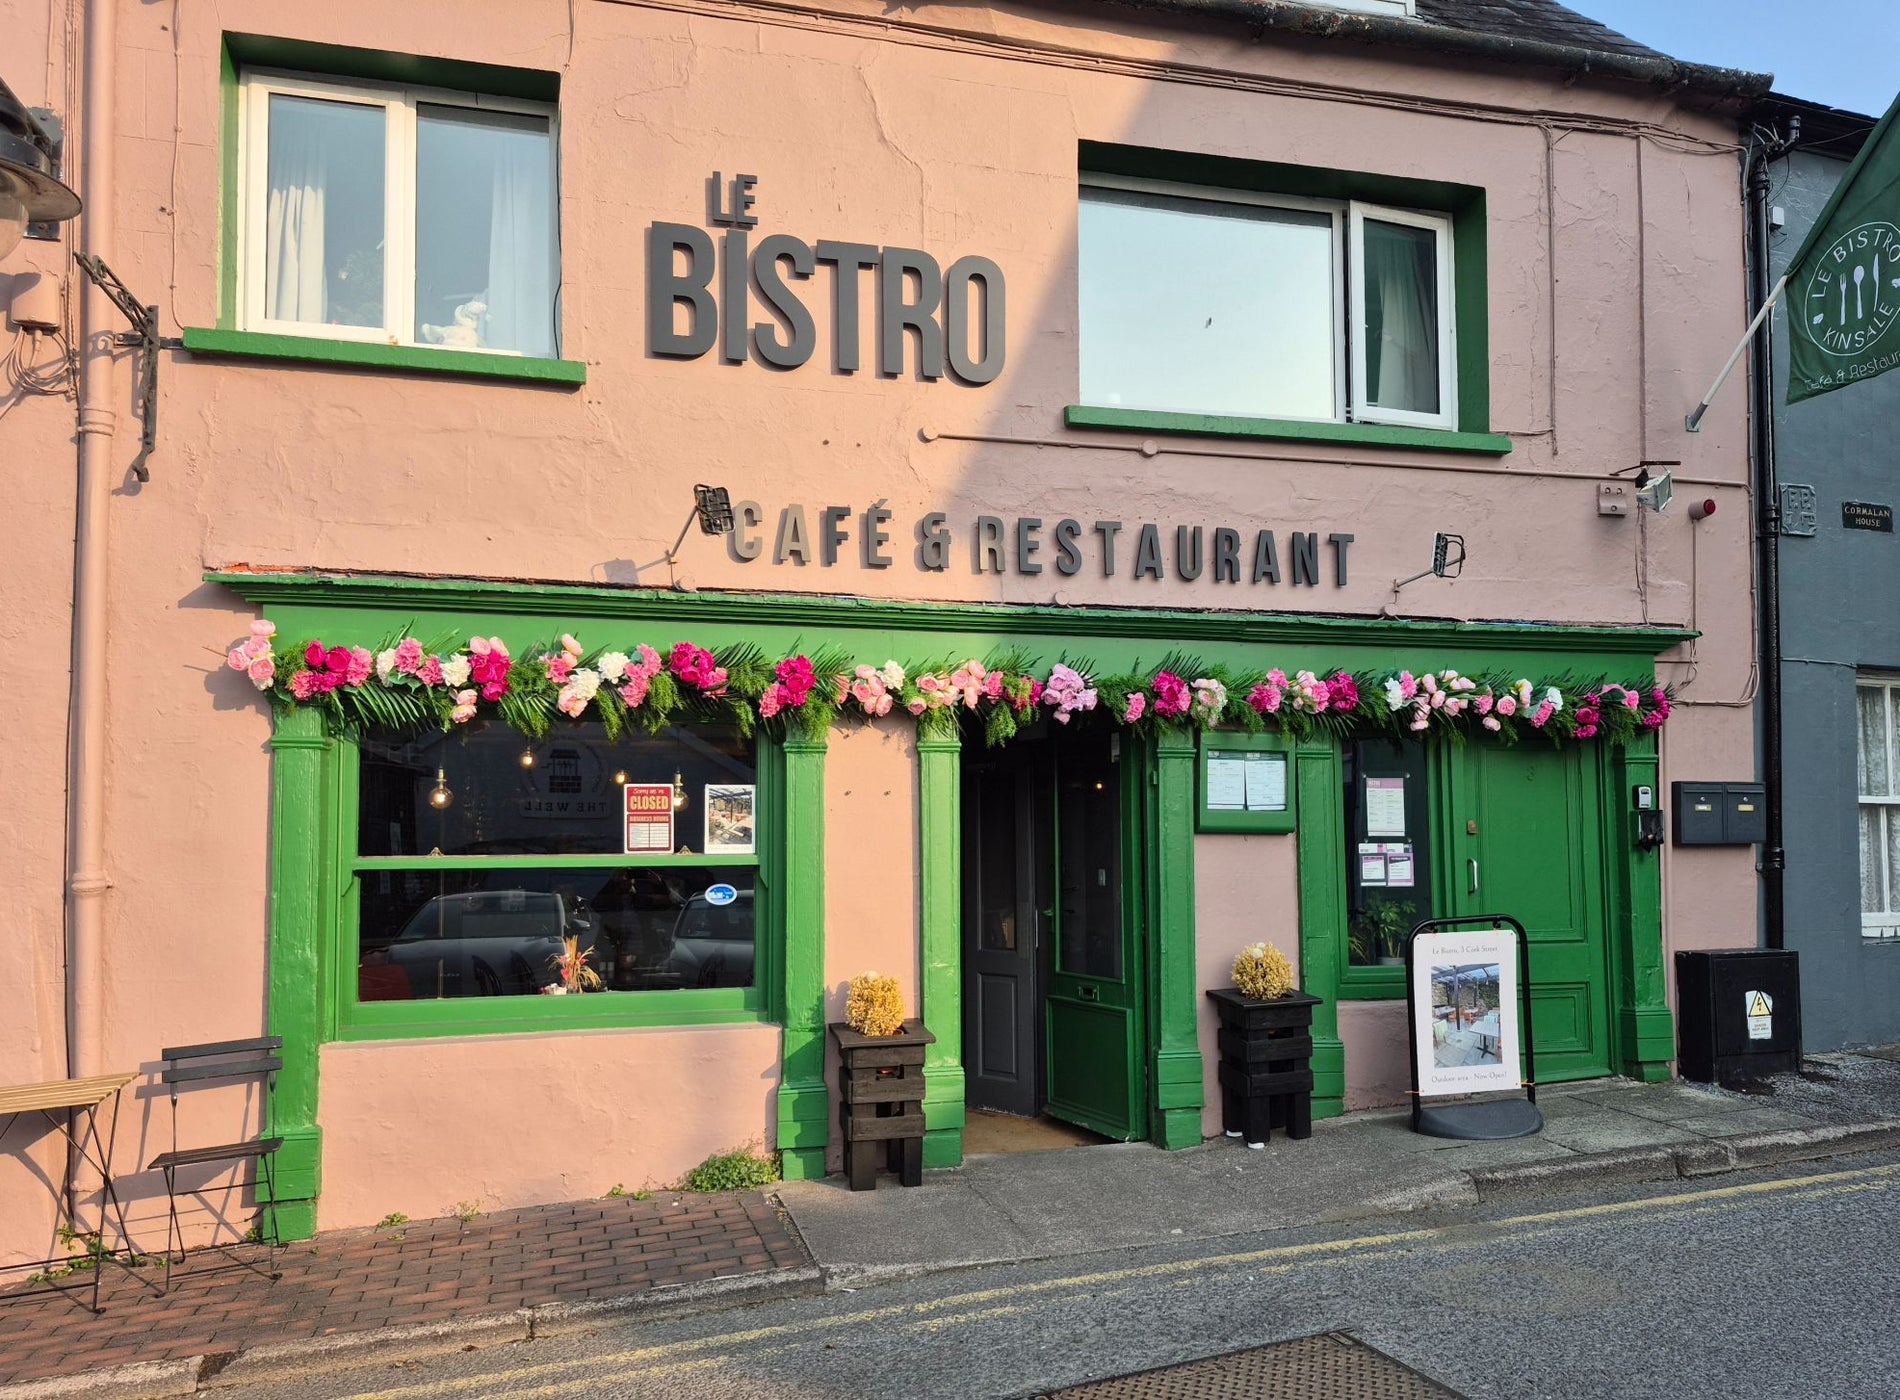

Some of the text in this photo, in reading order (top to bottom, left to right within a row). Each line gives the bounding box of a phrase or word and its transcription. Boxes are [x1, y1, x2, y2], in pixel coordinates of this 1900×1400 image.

[712, 171, 758, 226] LE
[1811, 229, 1900, 298] LE BISTRO
[651, 221, 1006, 384] BISTRO
[1823, 302, 1893, 350] KINSALE
[1849, 351, 1900, 379] Restaur
[1844, 505, 1890, 517] CORMALAN
[1855, 517, 1881, 527] HOUSE
[734, 498, 1355, 587] CAFÉ & RESTAURANT
[630, 795, 668, 810] CLOSED
